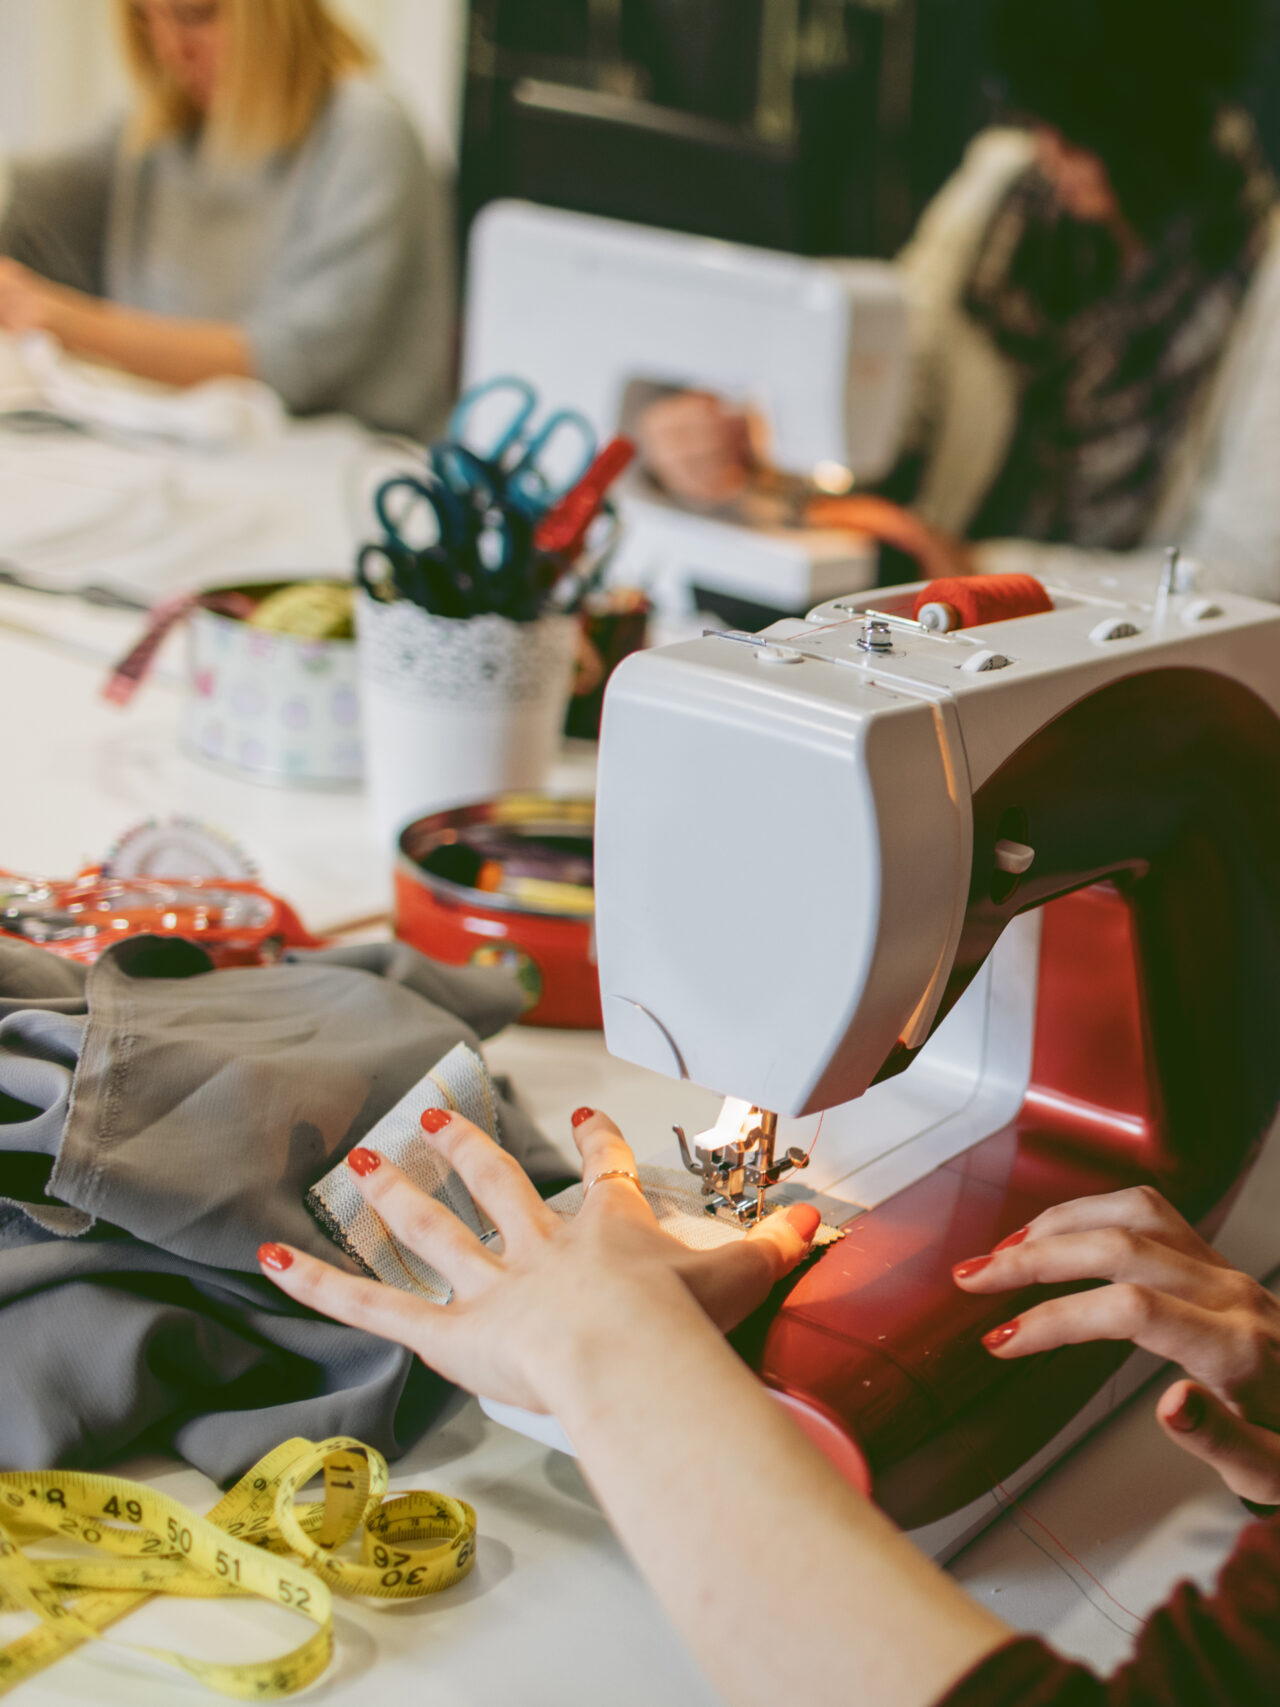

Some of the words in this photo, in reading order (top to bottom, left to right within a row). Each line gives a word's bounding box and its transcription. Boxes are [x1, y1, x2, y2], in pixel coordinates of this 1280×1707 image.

[329, 1464, 354, 1490] 11
[102, 1495, 143, 1523] 49
[59, 1517, 102, 1543] 20
[167, 1516, 193, 1553] 50
[227, 1516, 271, 1537] 22
[215, 1549, 241, 1582] 51
[279, 1579, 313, 1614] 52
